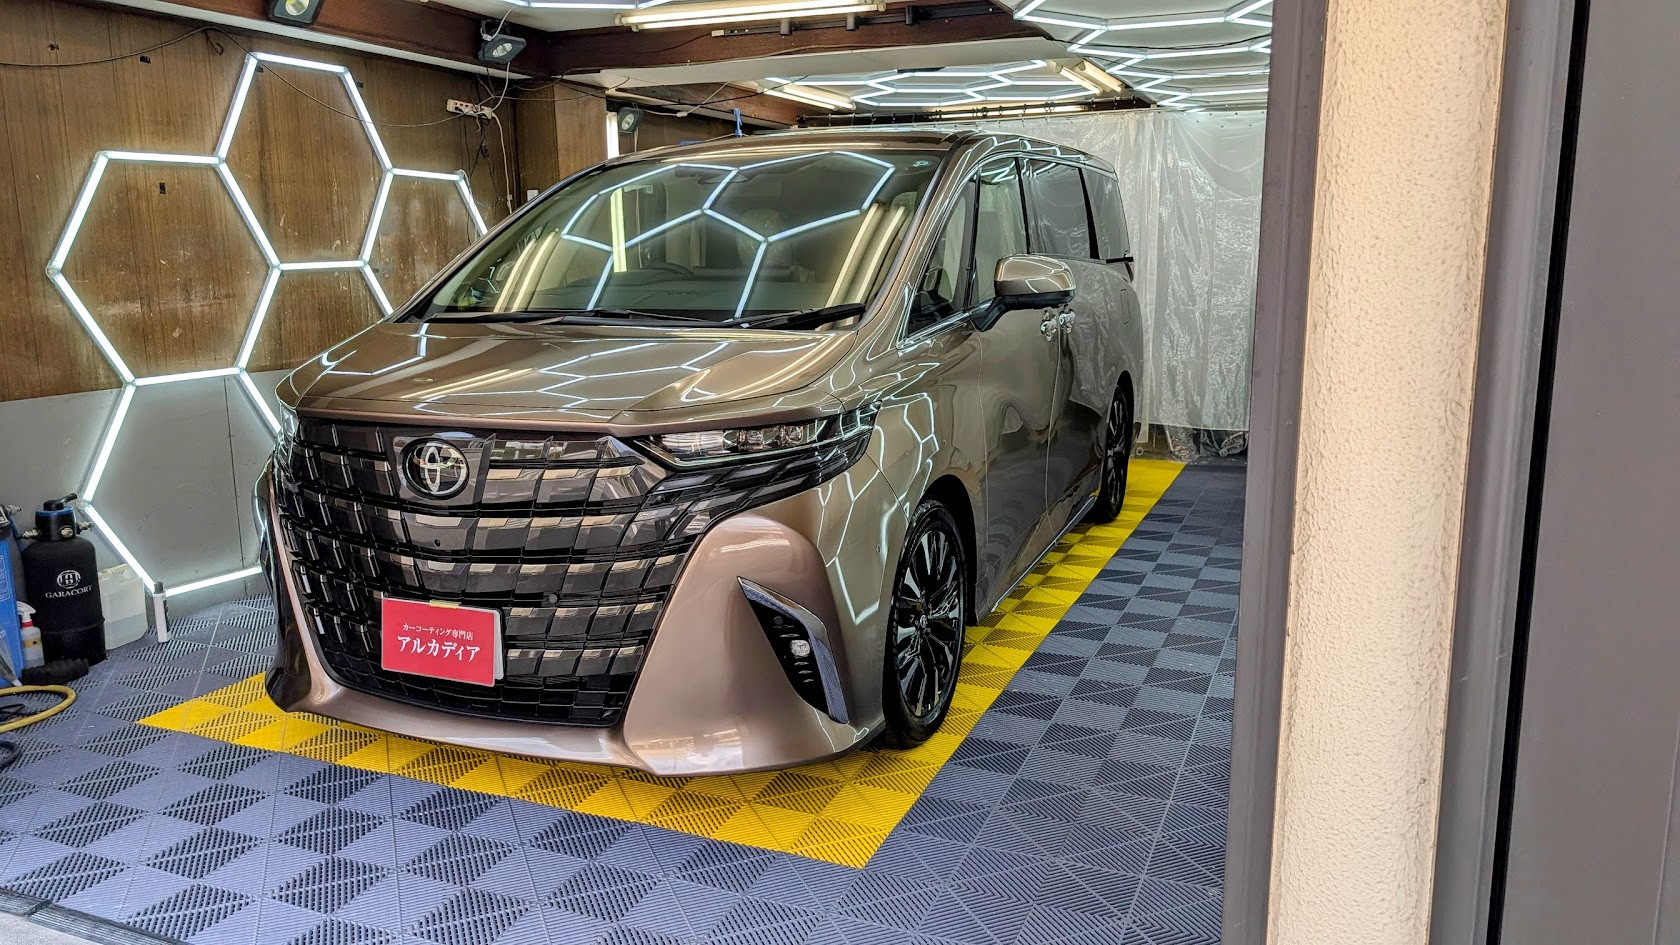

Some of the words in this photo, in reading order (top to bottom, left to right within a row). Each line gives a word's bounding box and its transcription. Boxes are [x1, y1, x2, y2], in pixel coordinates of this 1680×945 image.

[45, 584, 93, 599] GARACORT
[403, 623, 474, 641] カーコーティング専門店
[397, 635, 481, 662] アルカディア
